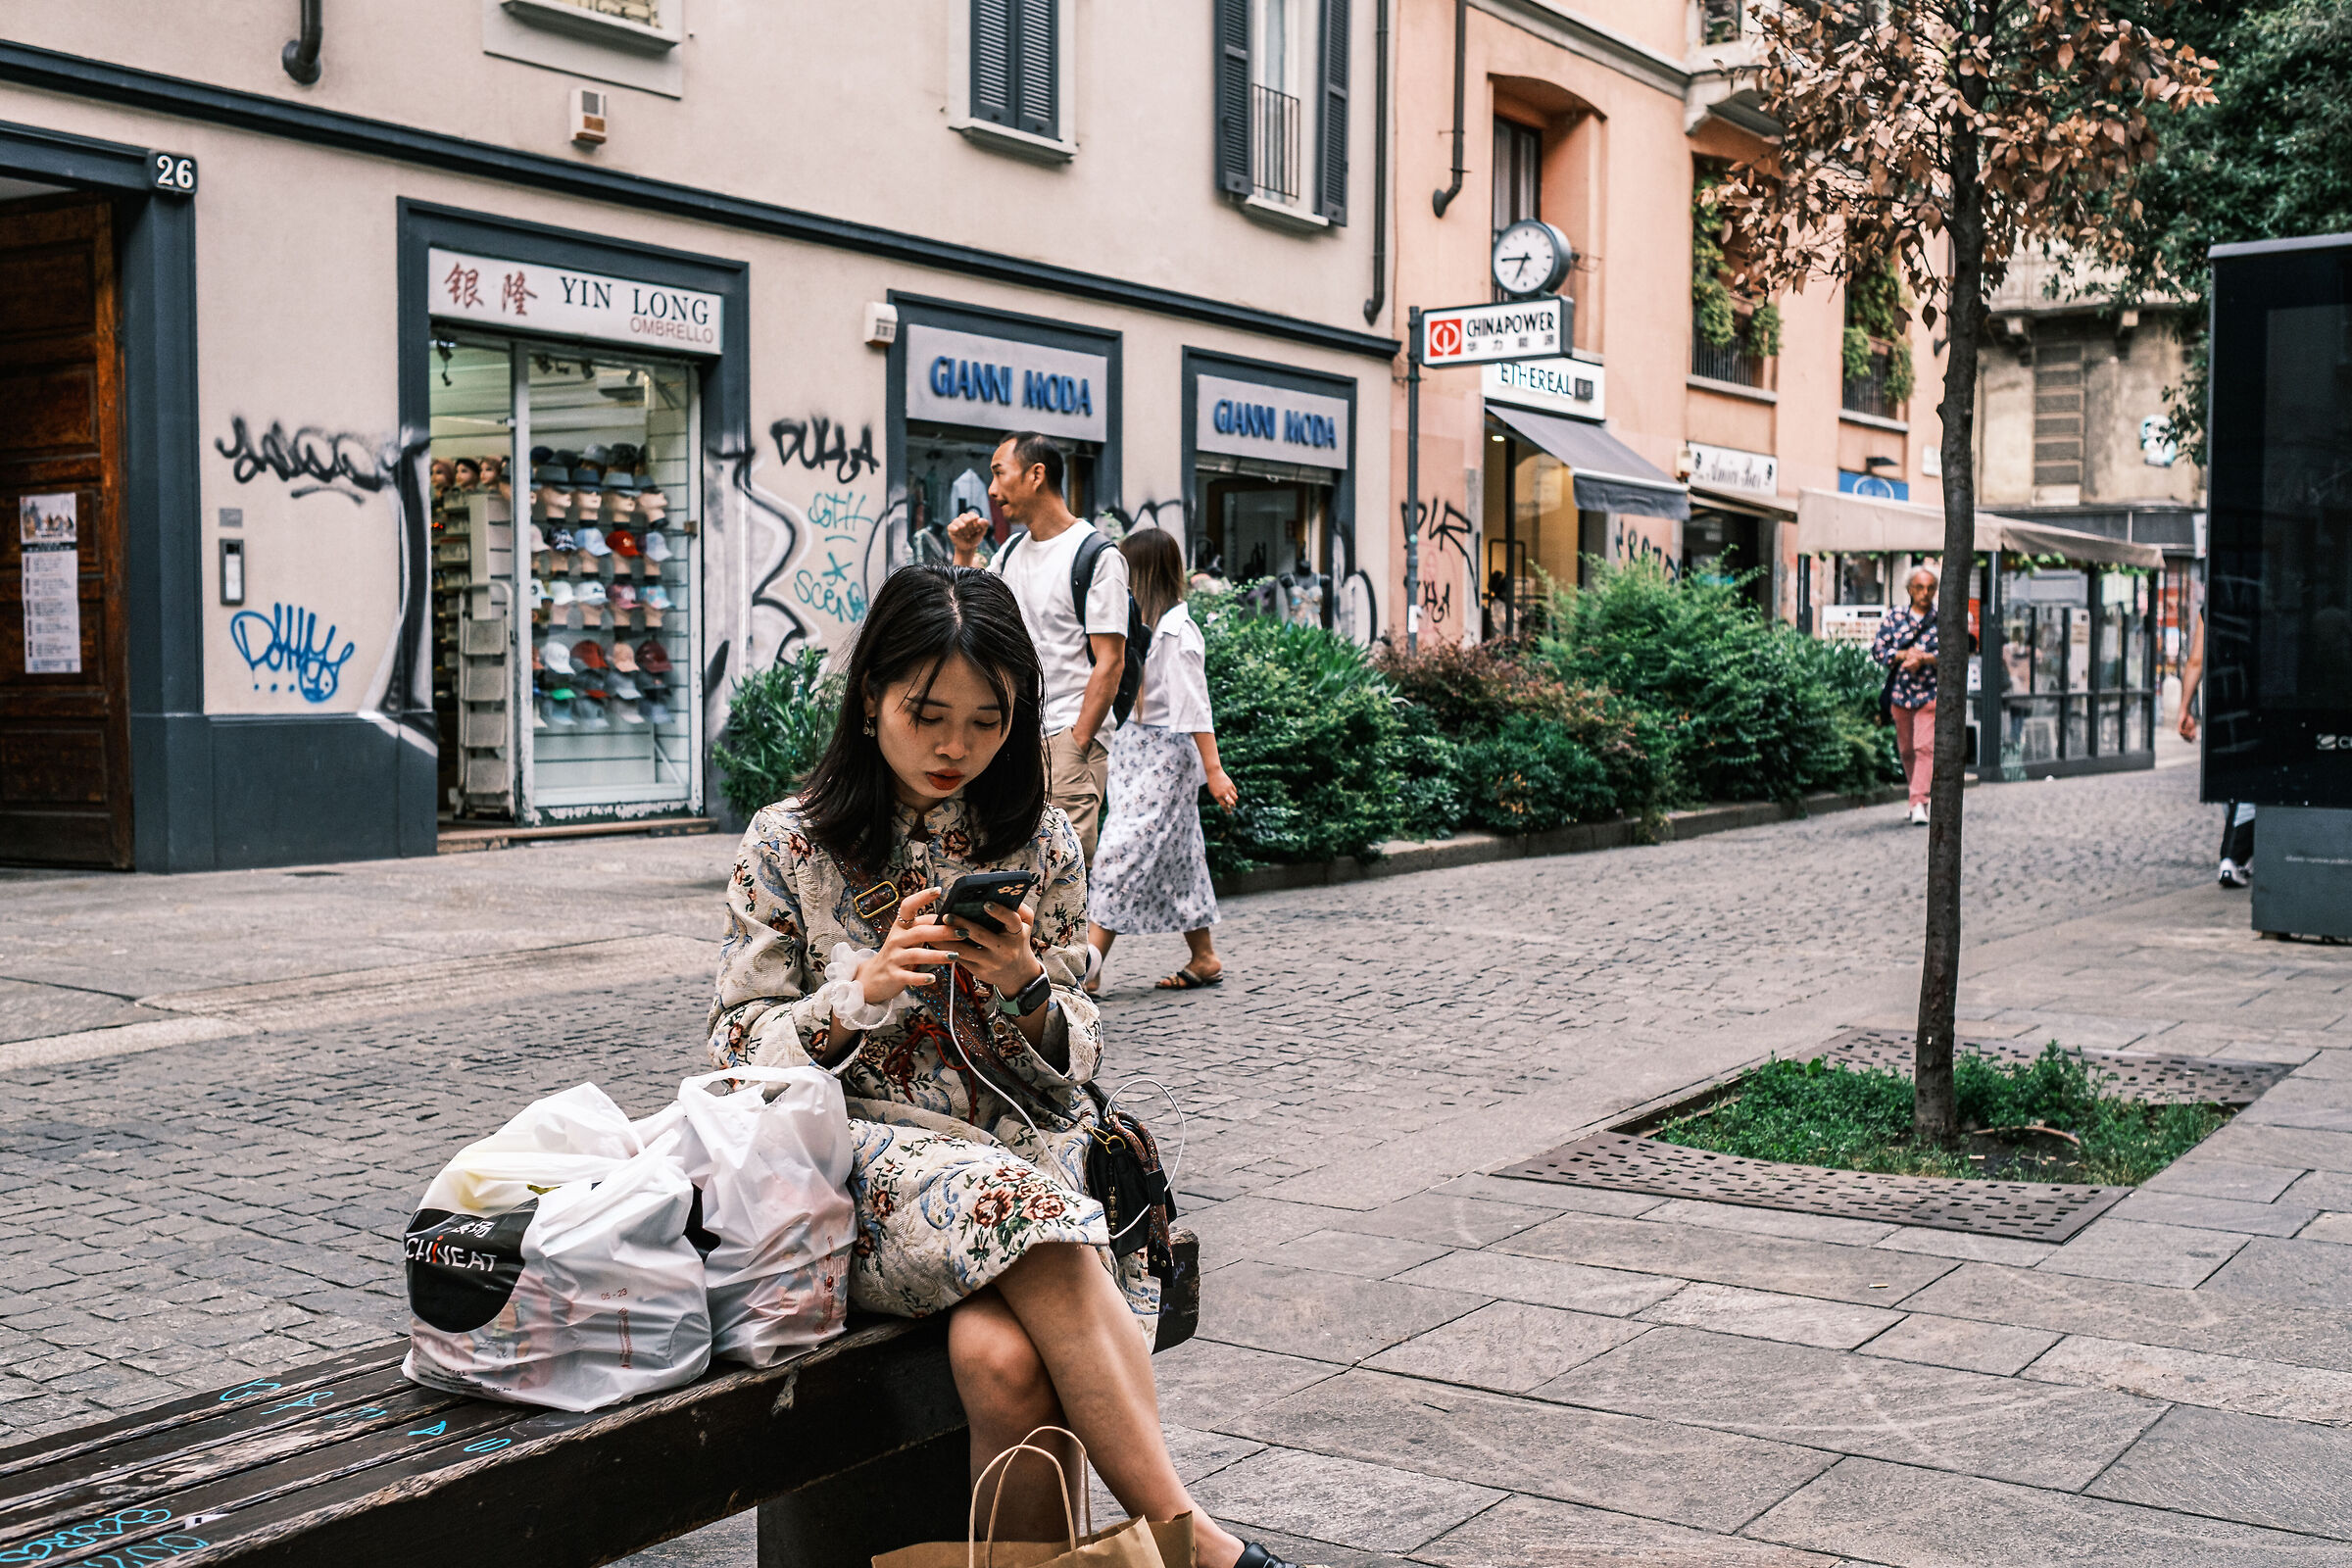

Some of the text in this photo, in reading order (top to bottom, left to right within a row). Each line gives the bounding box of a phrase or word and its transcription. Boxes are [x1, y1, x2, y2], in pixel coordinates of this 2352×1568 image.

[157, 155, 194, 189] 26
[560, 275, 710, 325] YIN LONG
[629, 316, 714, 344] OMBRELLO
[1466, 312, 1554, 338] CHINAPOWER
[930, 355, 1093, 416] GIANNI MODA
[1500, 363, 1573, 396] ETHEREAL
[1213, 398, 1338, 450] GIANNI MODA
